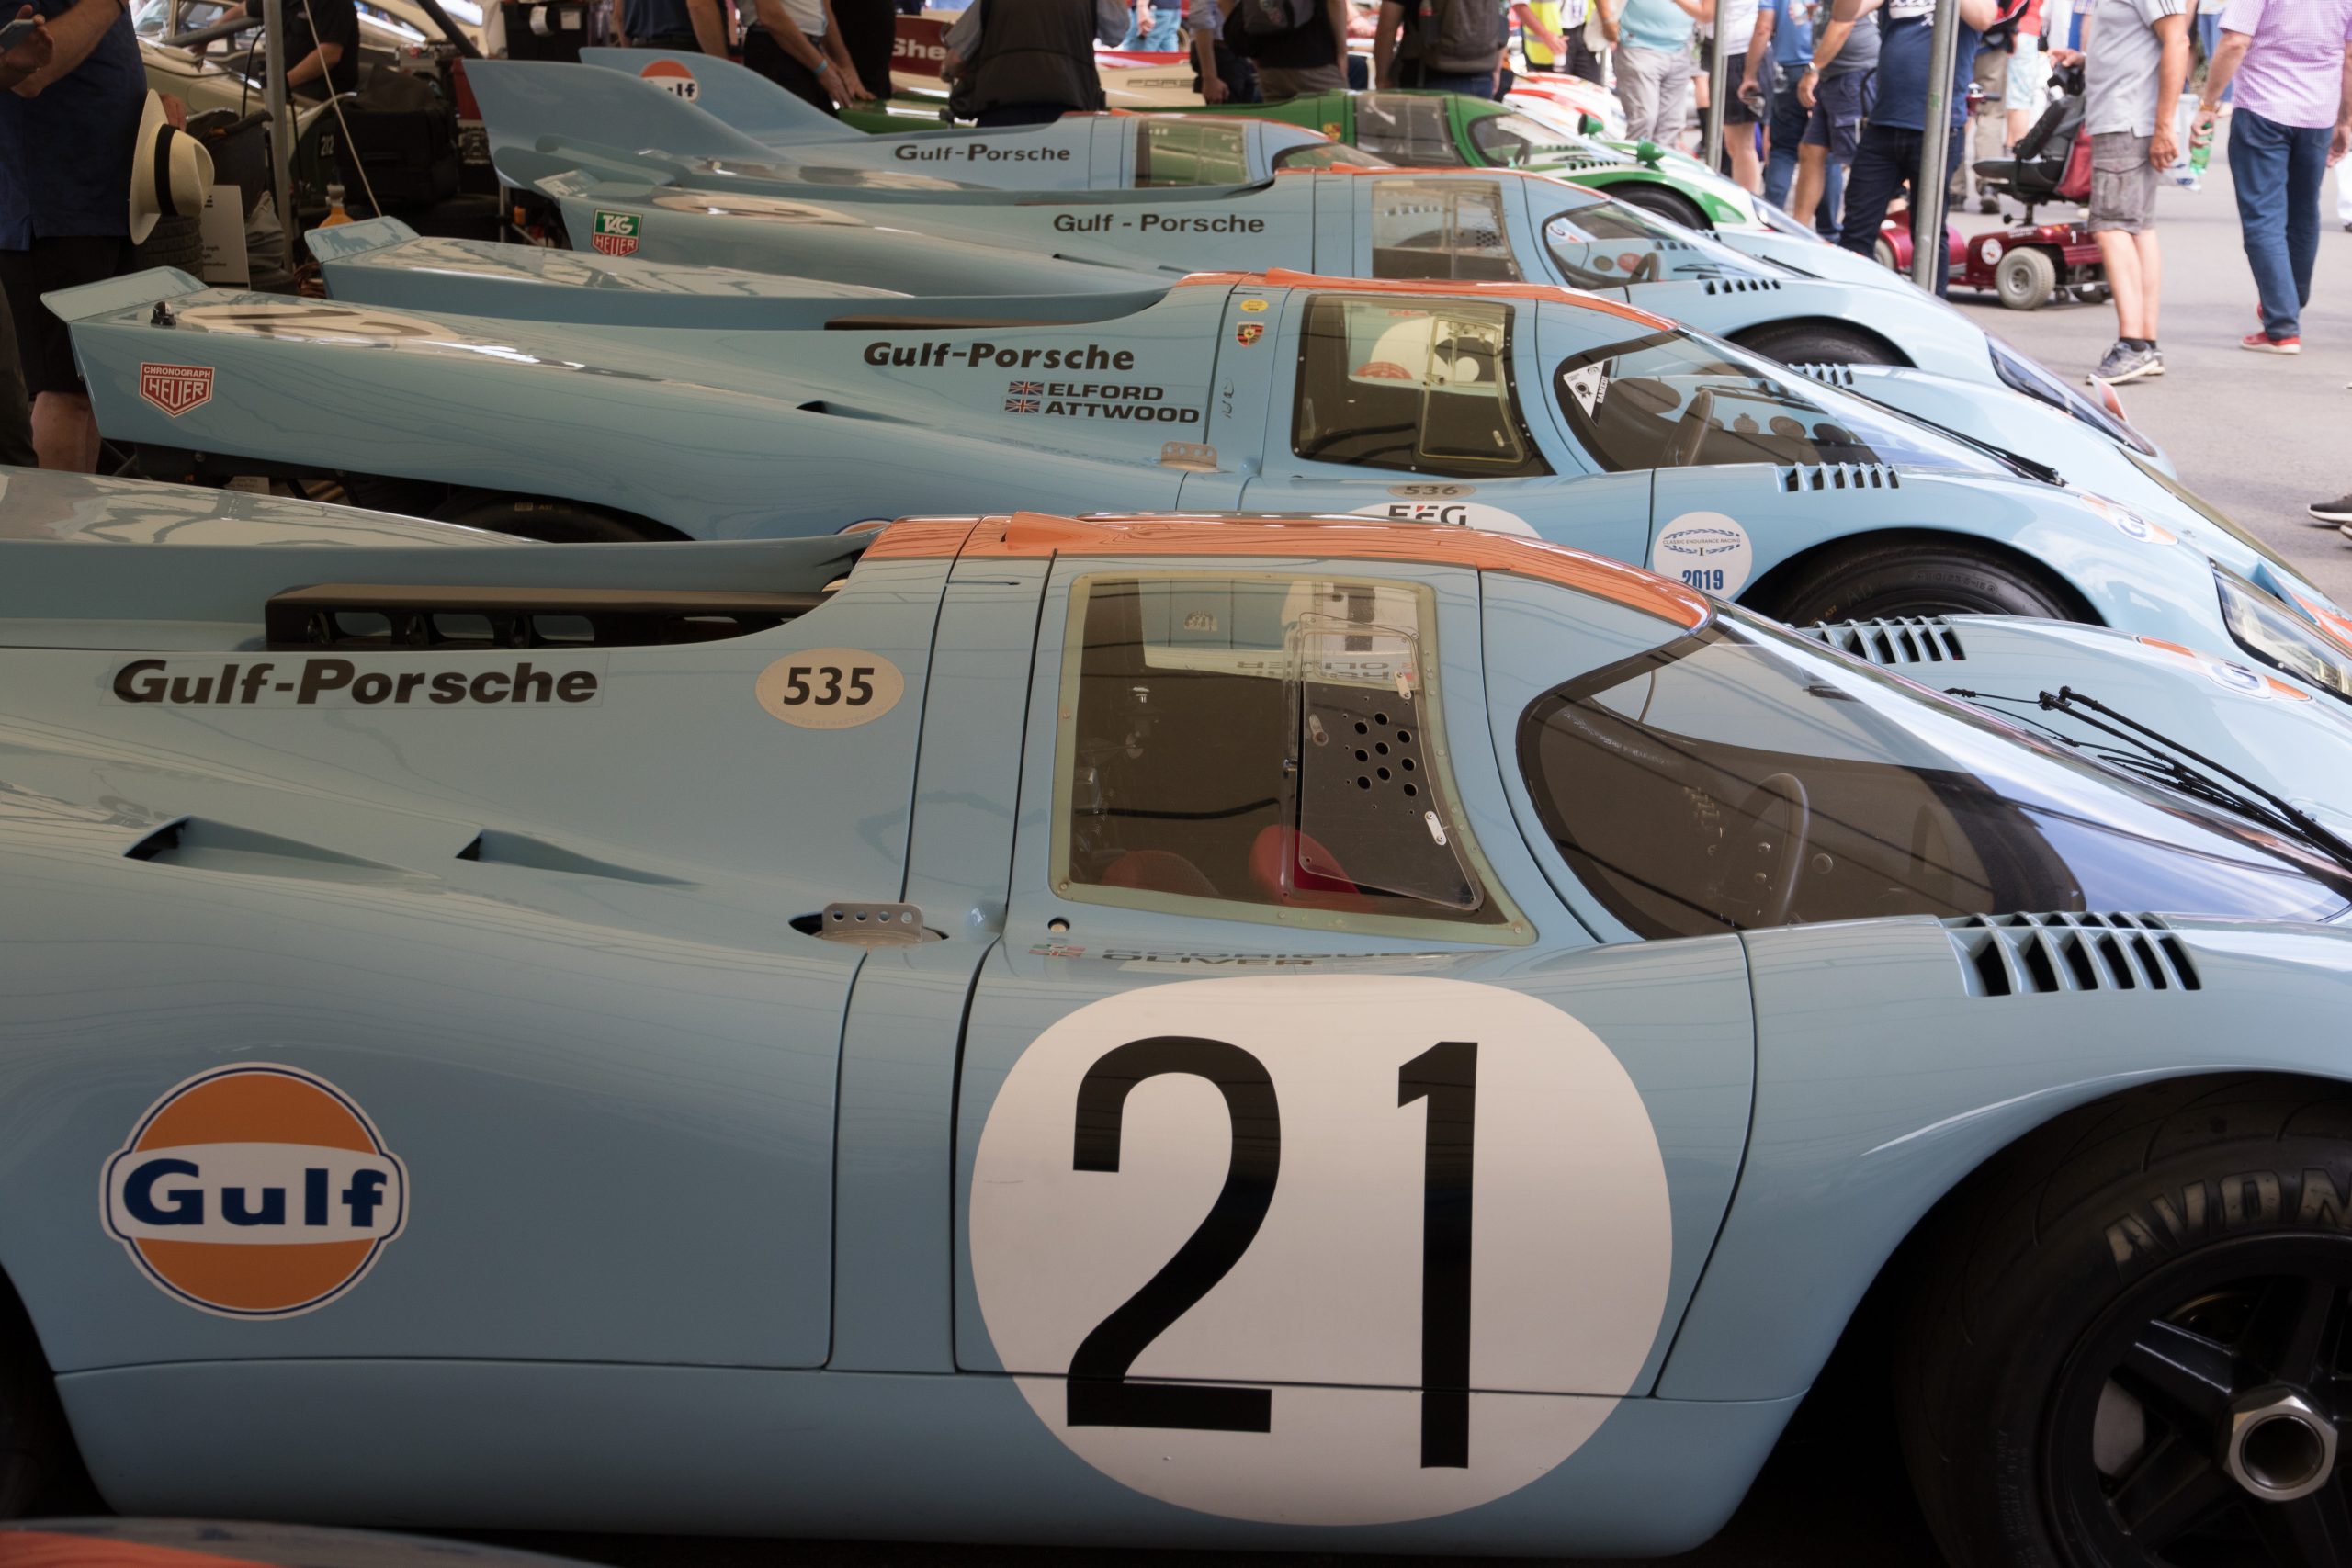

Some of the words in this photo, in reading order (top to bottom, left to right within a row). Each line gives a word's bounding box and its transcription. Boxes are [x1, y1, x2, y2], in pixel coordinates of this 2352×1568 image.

[892, 38, 946, 60] She
[894, 143, 1070, 162] Gulf-Porsche
[603, 214, 633, 234] TAG
[1053, 214, 1114, 231] Gulf
[1140, 214, 1265, 232] Porsche
[595, 236, 635, 256] HEUER
[864, 342, 1134, 370] Gulf-Porsche
[144, 366, 211, 378] CHRONOGRAPH
[149, 378, 205, 408] HEUER
[1047, 383, 1164, 400] ELFORD
[1044, 401, 1199, 423] ATTWOOD
[1404, 486, 1459, 495] 536
[1682, 570, 1724, 590] 2019
[113, 659, 597, 705] Gulf-Porsche
[784, 667, 875, 705] 535
[1103, 954, 1314, 965] OLIVER
[123, 1158, 387, 1227] Gulf
[2103, 1168, 2352, 1281] AVON
[1067, 1035, 1478, 1469] 21
